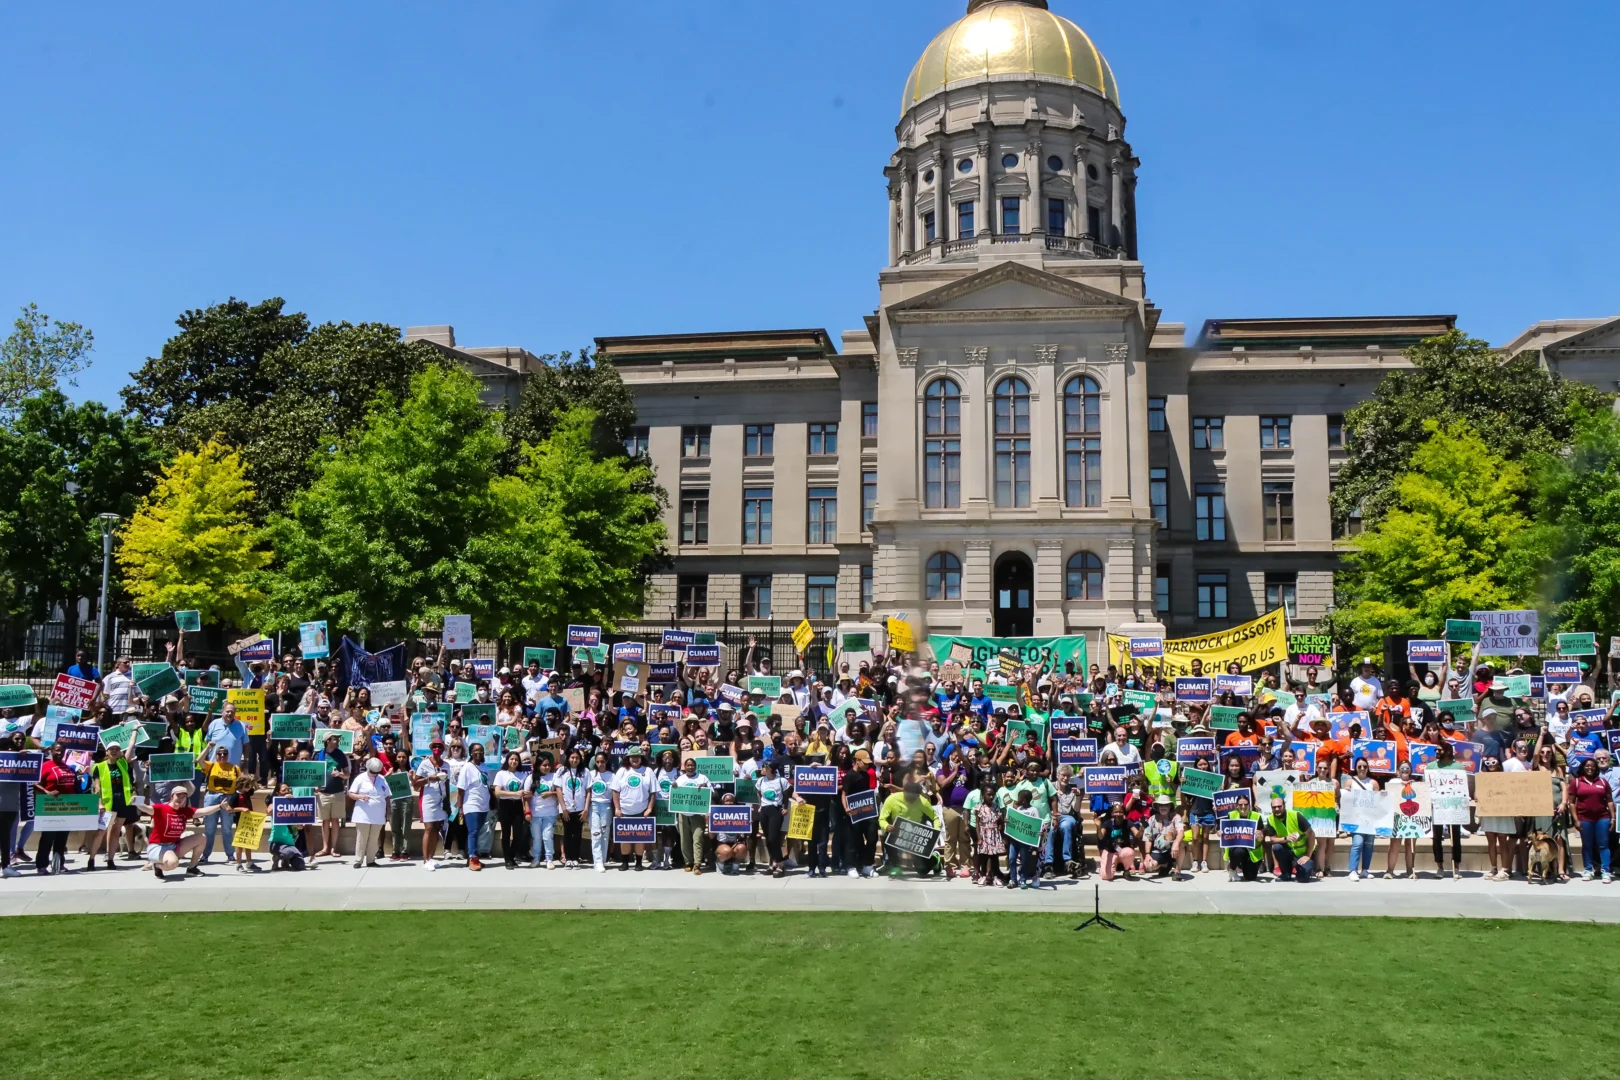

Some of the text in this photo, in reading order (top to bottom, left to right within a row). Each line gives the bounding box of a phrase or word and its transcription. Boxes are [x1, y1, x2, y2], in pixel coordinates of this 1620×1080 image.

[1499, 613, 1520, 624] FUELS
[571, 630, 598, 638] CLIMATE
[1163, 617, 1277, 653] WARNOCK OSSOFF
[1483, 626, 1500, 636] PONS
[665, 634, 693, 643] CLIMATE
[1291, 634, 1332, 645] ENERGY
[1491, 637, 1538, 648] DESTRUCTION
[1290, 644, 1330, 654] JUSTICE
[1261, 647, 1275, 662] US
[1299, 654, 1322, 664] NOW
[651, 667, 675, 675] LIMATE
[58, 681, 93, 695] RESTORE
[1219, 679, 1248, 687] CLIMATE
[191, 687, 218, 697] Climate
[1125, 691, 1150, 701] Climate
[64, 697, 88, 709] IGHTS
[59, 730, 96, 740] CLIMATE
[1061, 745, 1094, 753] CLIMATE
[1180, 743, 1212, 751] CLIMATE
[0, 760, 38, 769] CLIMATE
[798, 773, 834, 781] CLIMATE
[1088, 774, 1123, 782] CLIMATE
[1203, 777, 1215, 786] FOR
[276, 803, 313, 812] CLIMATE
[849, 797, 874, 809] CLIMATE
[713, 813, 748, 821] CLIMATE
[617, 824, 653, 832] CLIMATE
[1021, 821, 1032, 830] FOR
[1224, 826, 1253, 835] CLIMATE
[900, 821, 933, 843] GORGIA
[1017, 825, 1037, 838] FUTURE
[898, 830, 929, 847] VOTERS
[895, 837, 924, 854] MATTER
